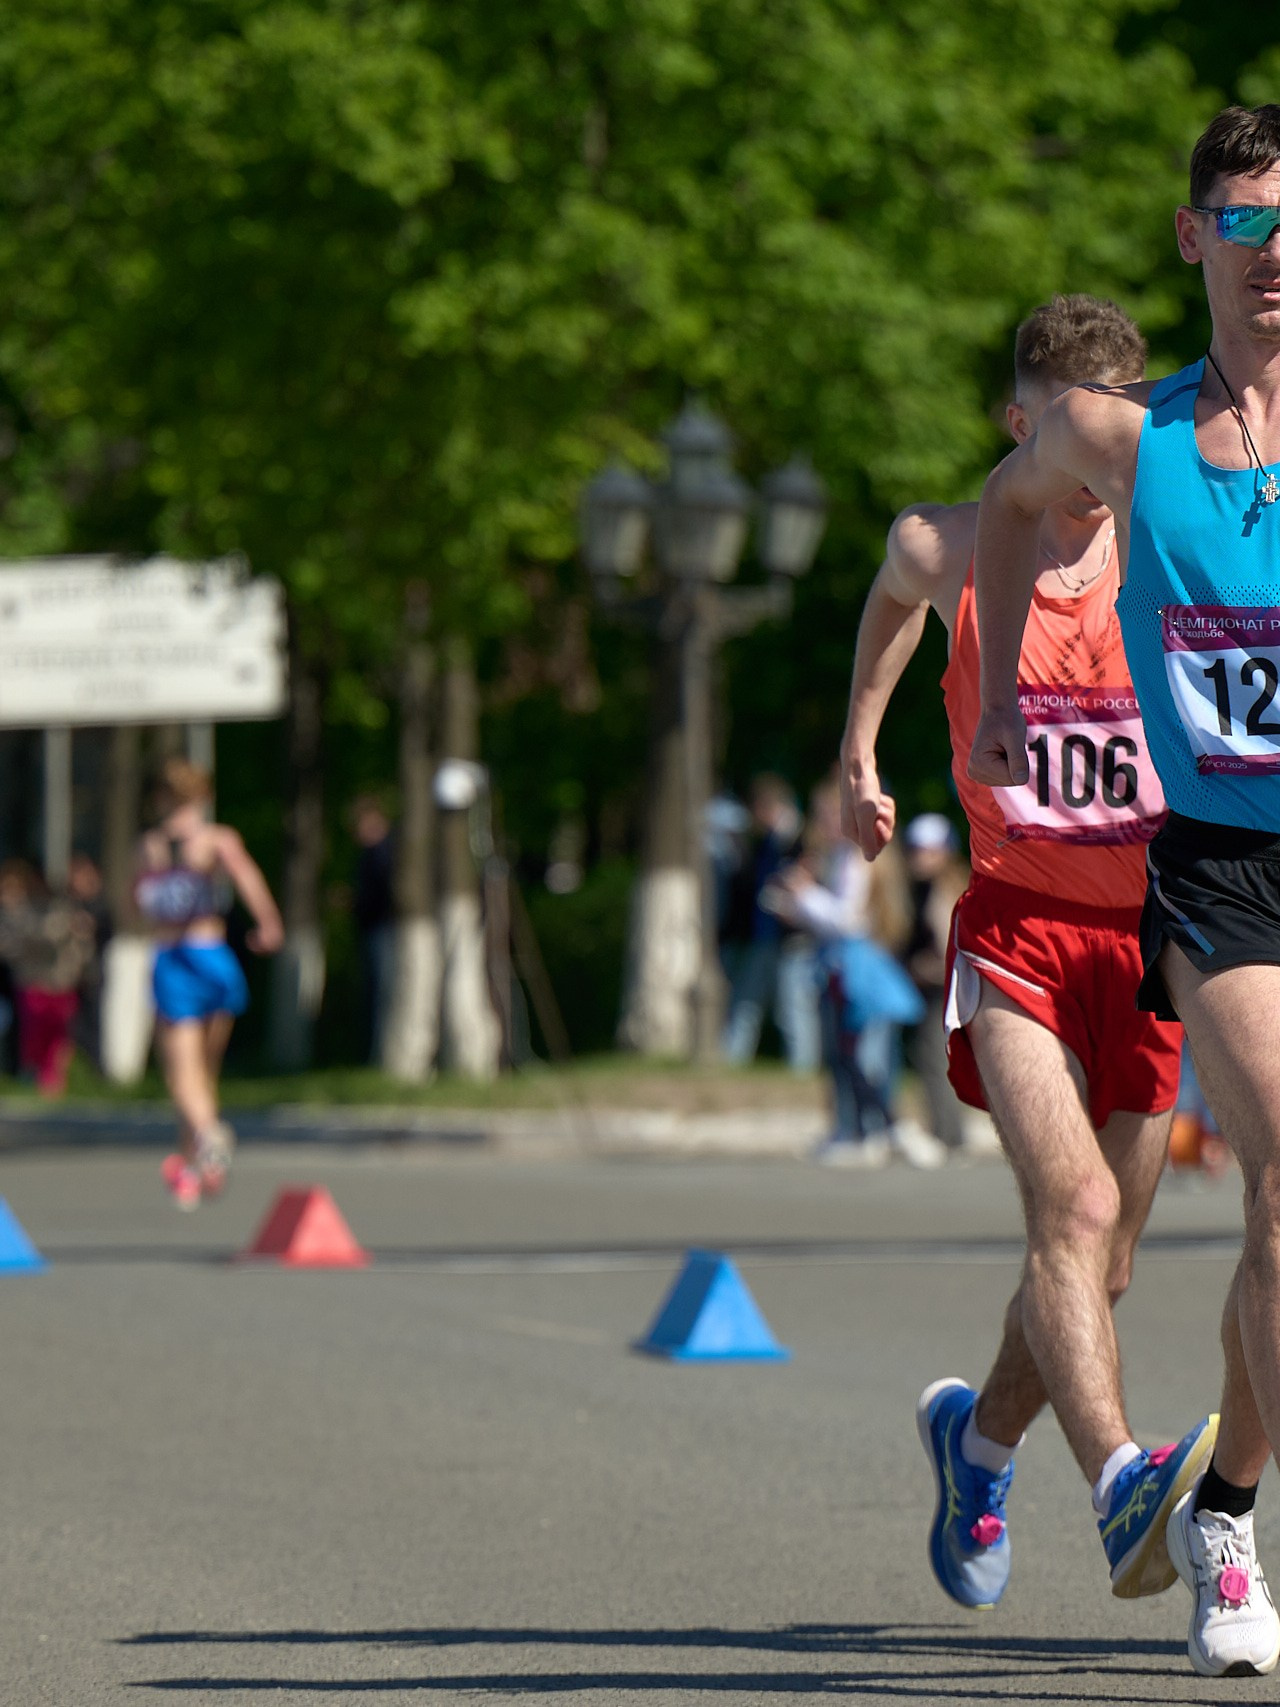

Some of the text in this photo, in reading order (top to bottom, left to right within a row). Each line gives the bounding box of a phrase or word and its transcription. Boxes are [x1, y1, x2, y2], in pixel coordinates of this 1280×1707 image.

[1170, 616, 1266, 631] ЧЕМПИОНАТ
[1169, 628, 1225, 639] по ходьбе
[1018, 694, 1140, 711] МПИОНАТ РОСС
[1021, 706, 1049, 716] дьбе
[1028, 733, 1139, 809] 106
[1228, 761, 1248, 770] 2025
